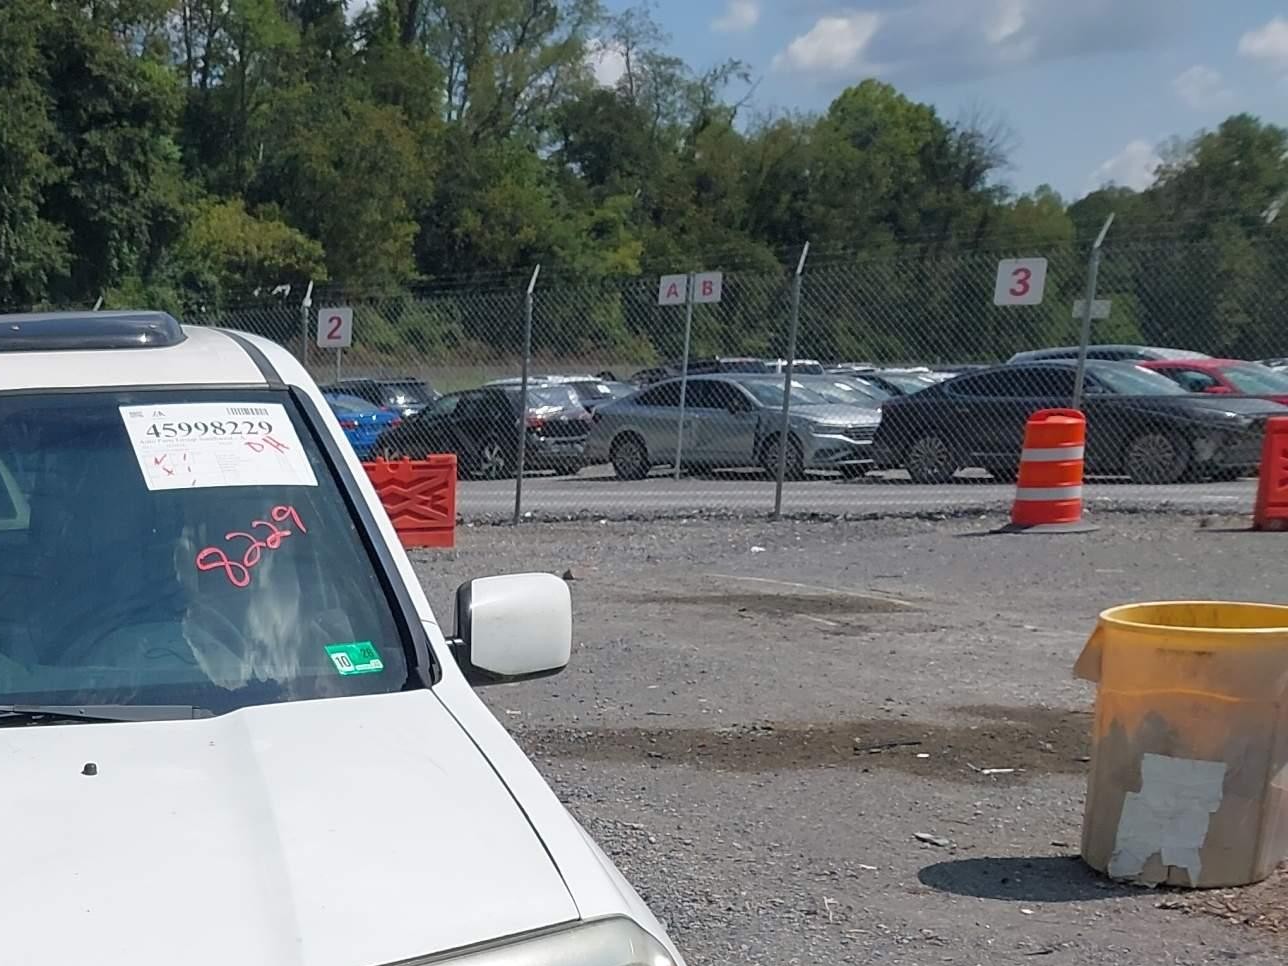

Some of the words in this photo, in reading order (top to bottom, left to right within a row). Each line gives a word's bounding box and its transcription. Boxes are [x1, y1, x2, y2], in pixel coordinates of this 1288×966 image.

[666, 281, 679, 298] A
[702, 280, 713, 296] B
[1009, 267, 1032, 296] 3
[327, 316, 343, 340] 2
[146, 421, 273, 438] 45998229
[196, 505, 307, 587] 8229
[335, 655, 352, 668] 10
